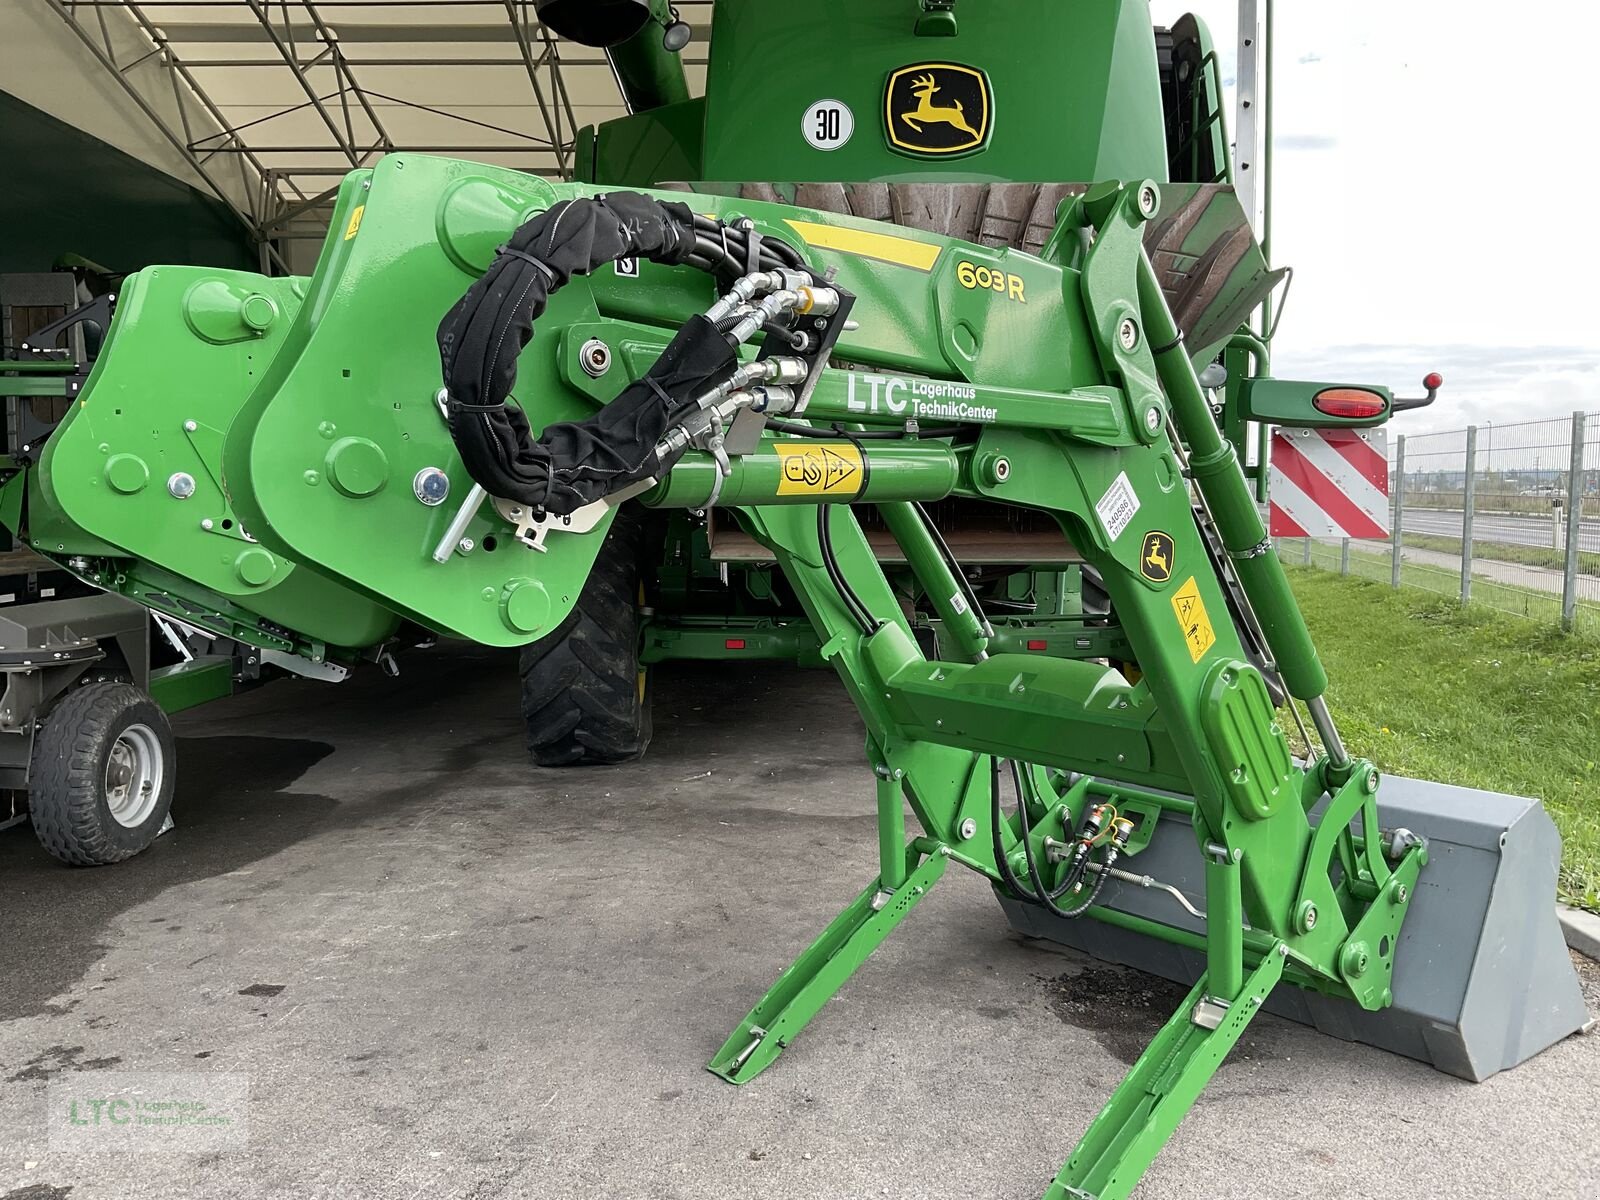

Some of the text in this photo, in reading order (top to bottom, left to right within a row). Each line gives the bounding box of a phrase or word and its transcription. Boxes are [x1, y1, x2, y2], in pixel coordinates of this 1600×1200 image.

[815, 108, 840, 141] 30
[847, 373, 909, 412] LTC
[911, 379, 976, 400] Lagerhaus
[911, 398, 998, 420] TechnikCenter
[1106, 499, 1130, 531] 240586
